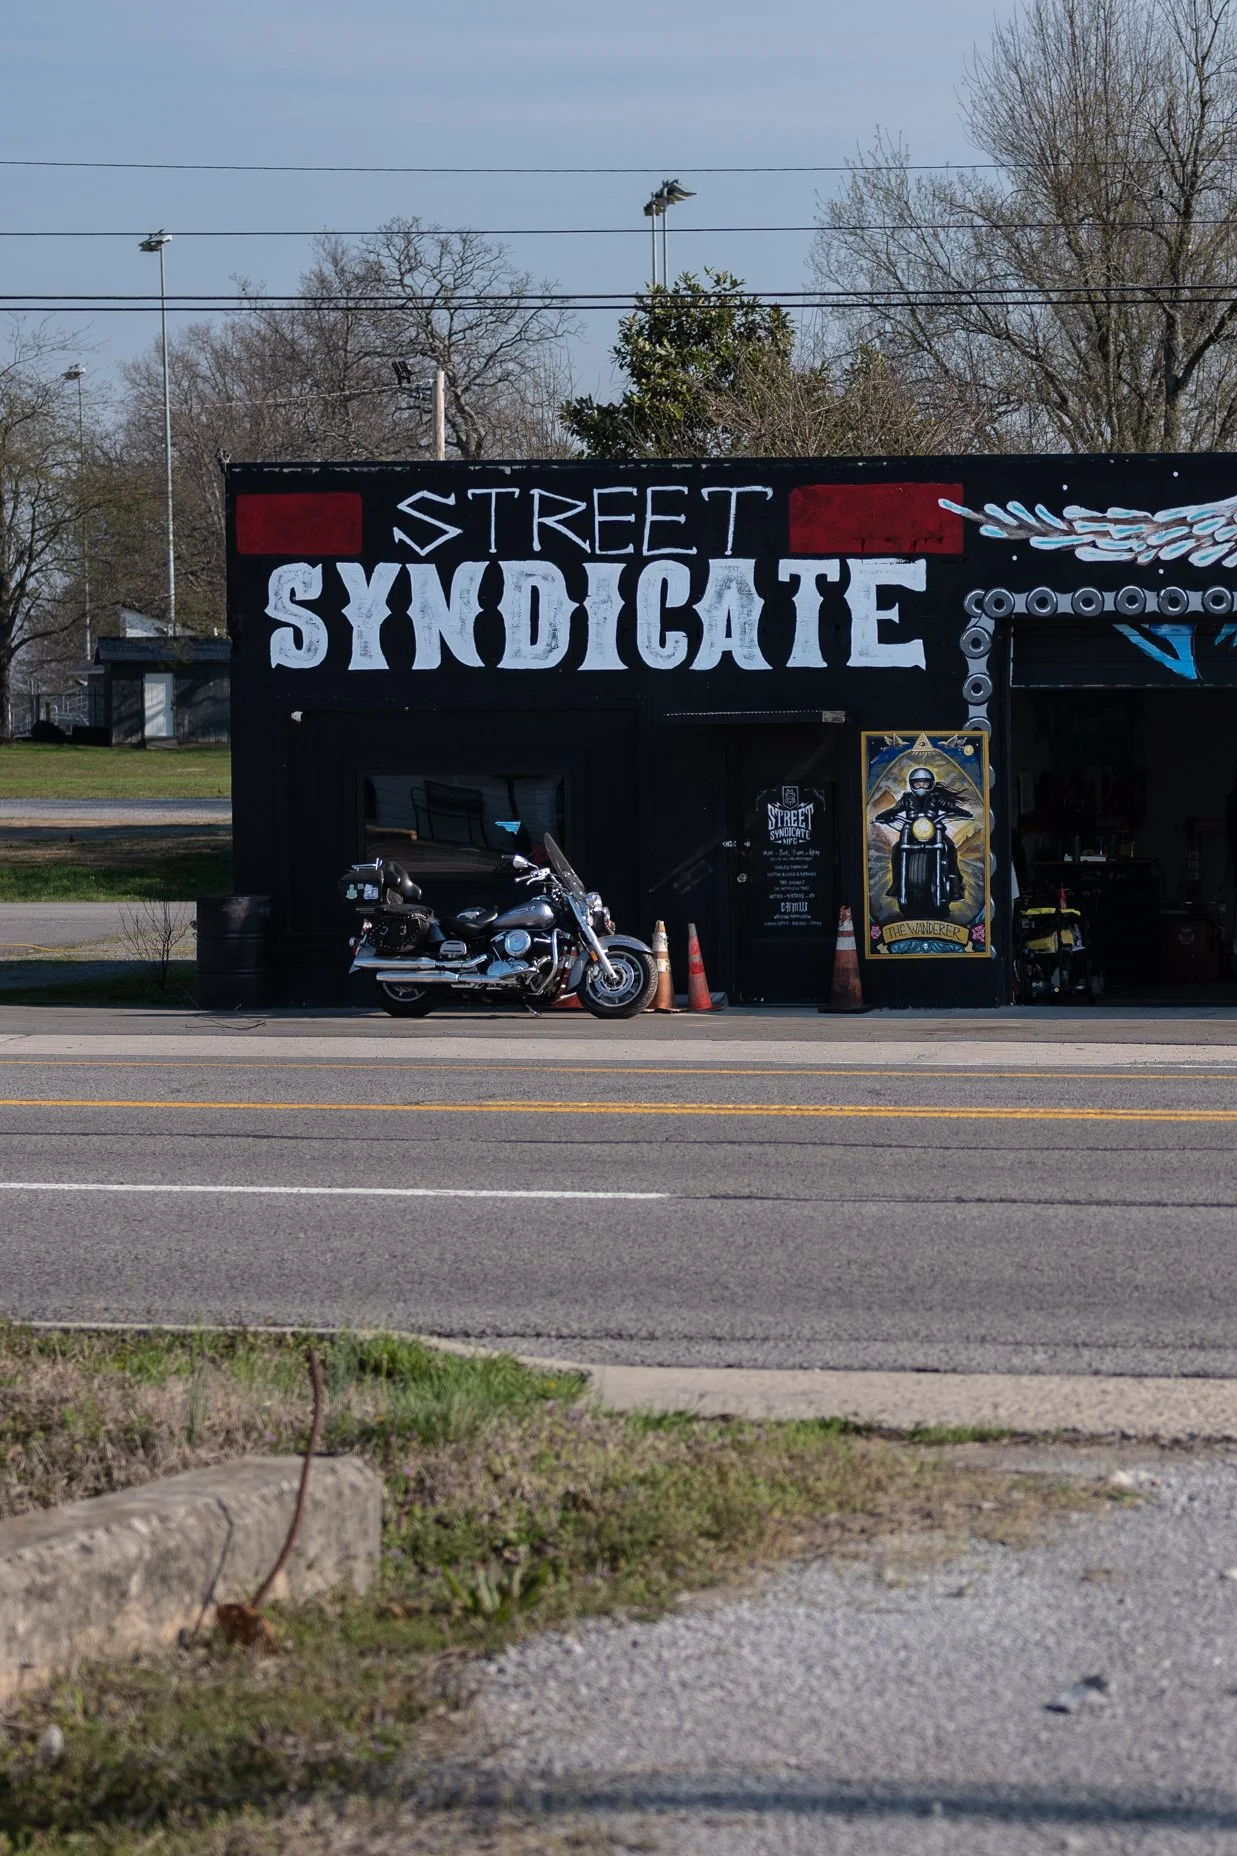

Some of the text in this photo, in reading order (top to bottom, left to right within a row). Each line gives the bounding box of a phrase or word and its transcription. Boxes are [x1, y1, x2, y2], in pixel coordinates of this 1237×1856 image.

[392, 484, 774, 556] STREET
[264, 557, 928, 671] SYNDICATE
[767, 802, 815, 831] STREET
[769, 826, 811, 841] SYNDICATE
[885, 921, 963, 942] THE WANDERER
